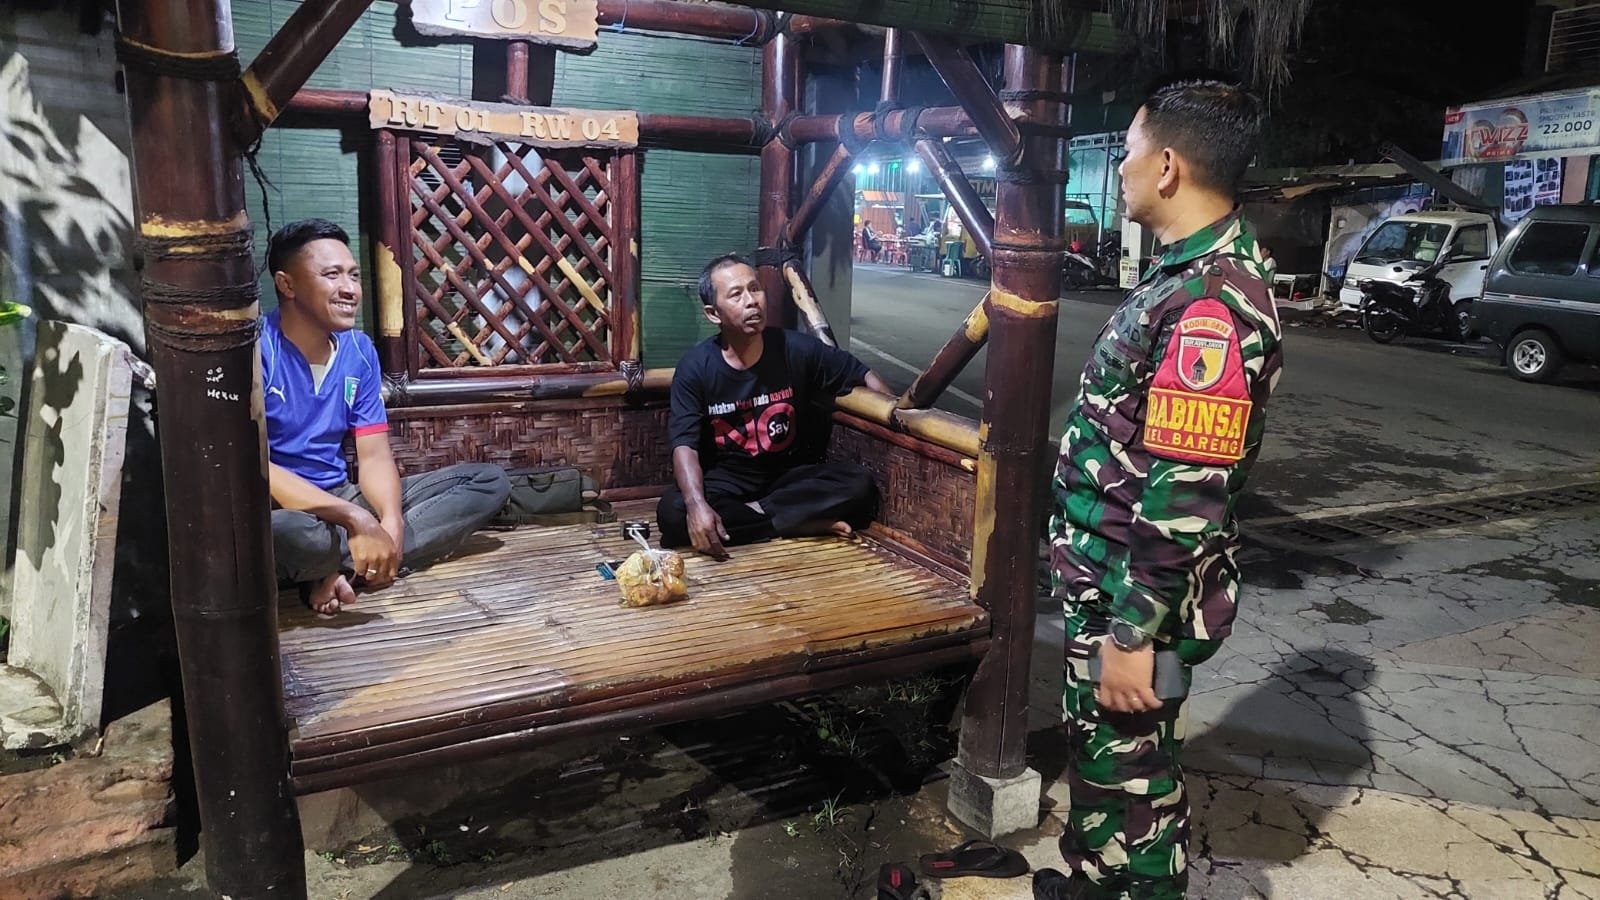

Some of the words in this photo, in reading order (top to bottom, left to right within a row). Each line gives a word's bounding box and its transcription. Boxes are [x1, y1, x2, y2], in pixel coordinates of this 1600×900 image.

[387, 97, 444, 128] RT
[455, 108, 492, 133] 01
[519, 111, 571, 140] RW
[581, 118, 620, 141] 04
[1543, 120, 1592, 135] 22.000
[768, 420, 790, 437] Say
[1147, 393, 1243, 439] BABINSA
